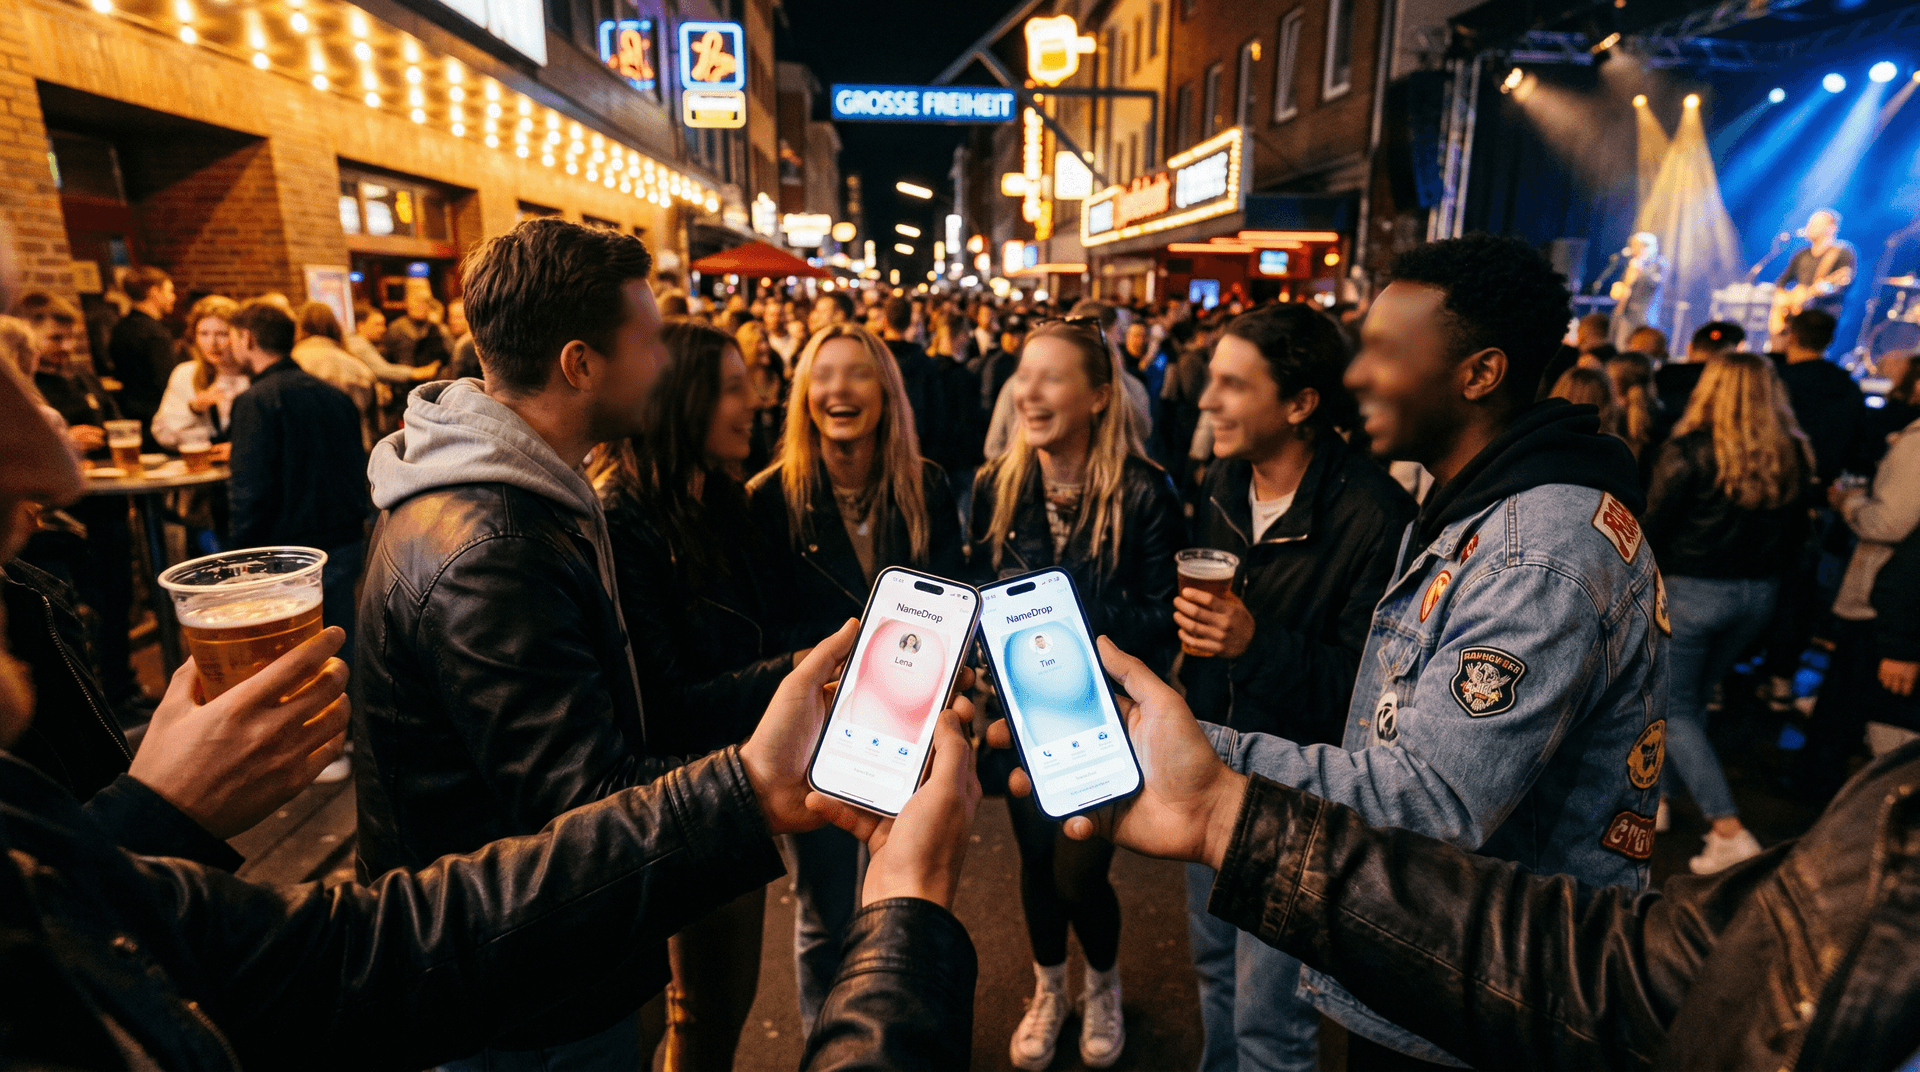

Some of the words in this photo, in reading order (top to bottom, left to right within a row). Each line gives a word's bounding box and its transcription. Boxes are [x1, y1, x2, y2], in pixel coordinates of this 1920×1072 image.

[835, 89, 920, 116] GROSSE
[922, 91, 1014, 118] FREIHEIT
[896, 602, 943, 624] NameDrop
[1006, 605, 1053, 624] NameDrop
[894, 656, 913, 668] Lena
[1040, 658, 1056, 668] Tim
